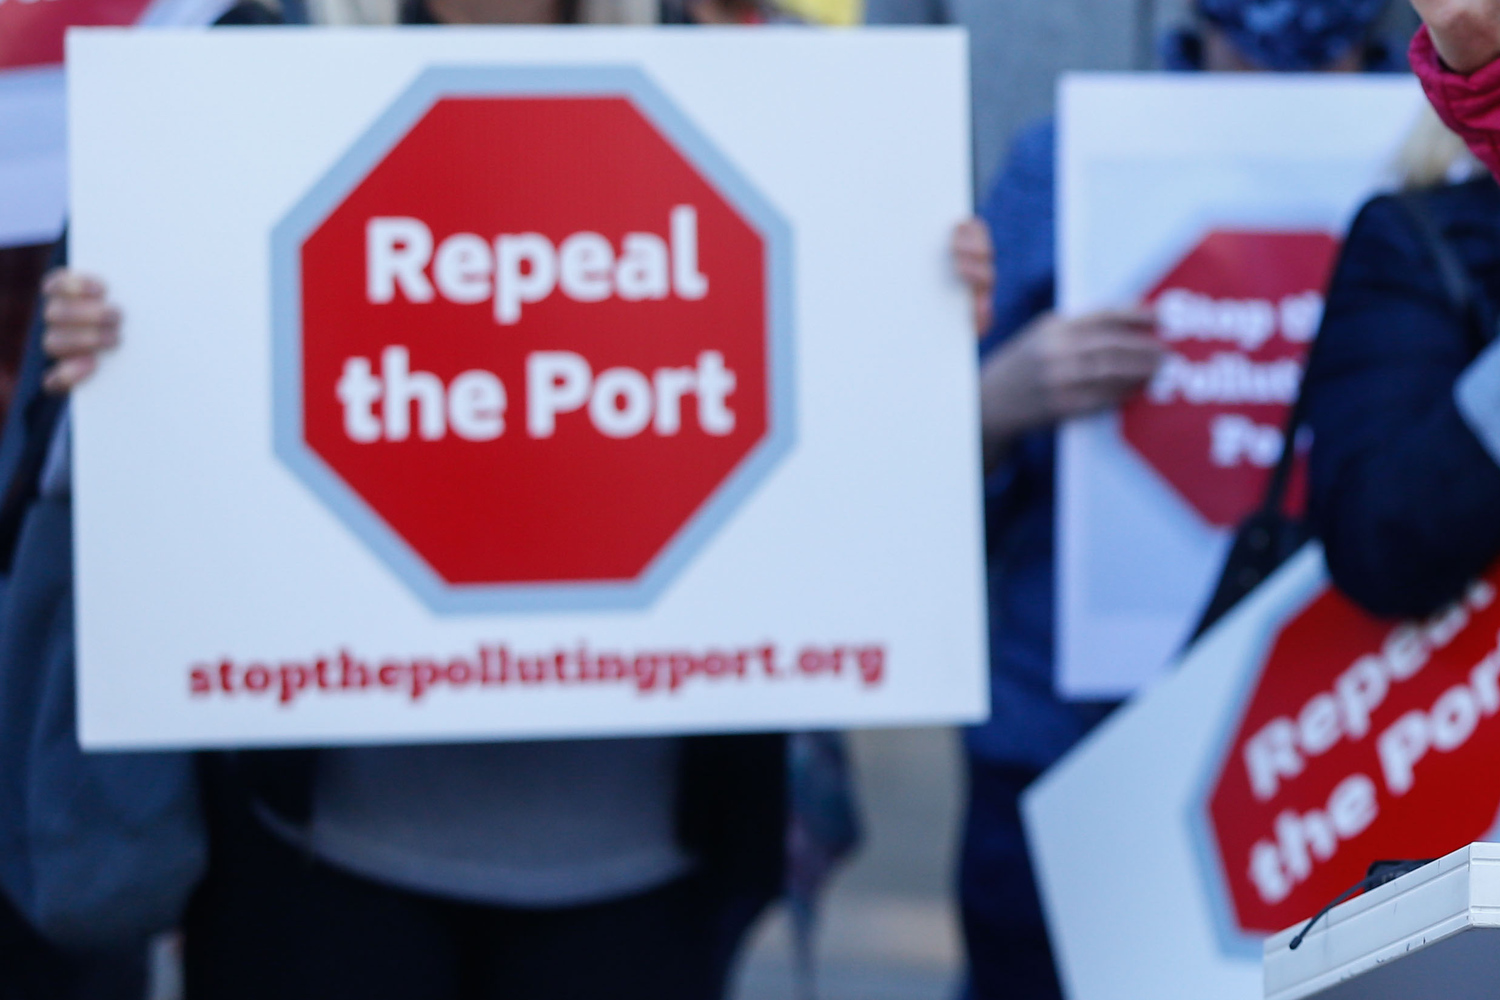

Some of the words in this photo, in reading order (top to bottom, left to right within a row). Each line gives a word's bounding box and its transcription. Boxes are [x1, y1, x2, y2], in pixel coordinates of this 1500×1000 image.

[365, 204, 709, 325] Repeal
[1157, 288, 1275, 350] Stop
[336, 345, 508, 443] the
[524, 350, 738, 438] Port
[1149, 353, 1300, 405] Pollut
[1209, 415, 1288, 468] Po
[189, 641, 887, 705] stopthepollutingport.org
[1248, 775, 1378, 905] the
